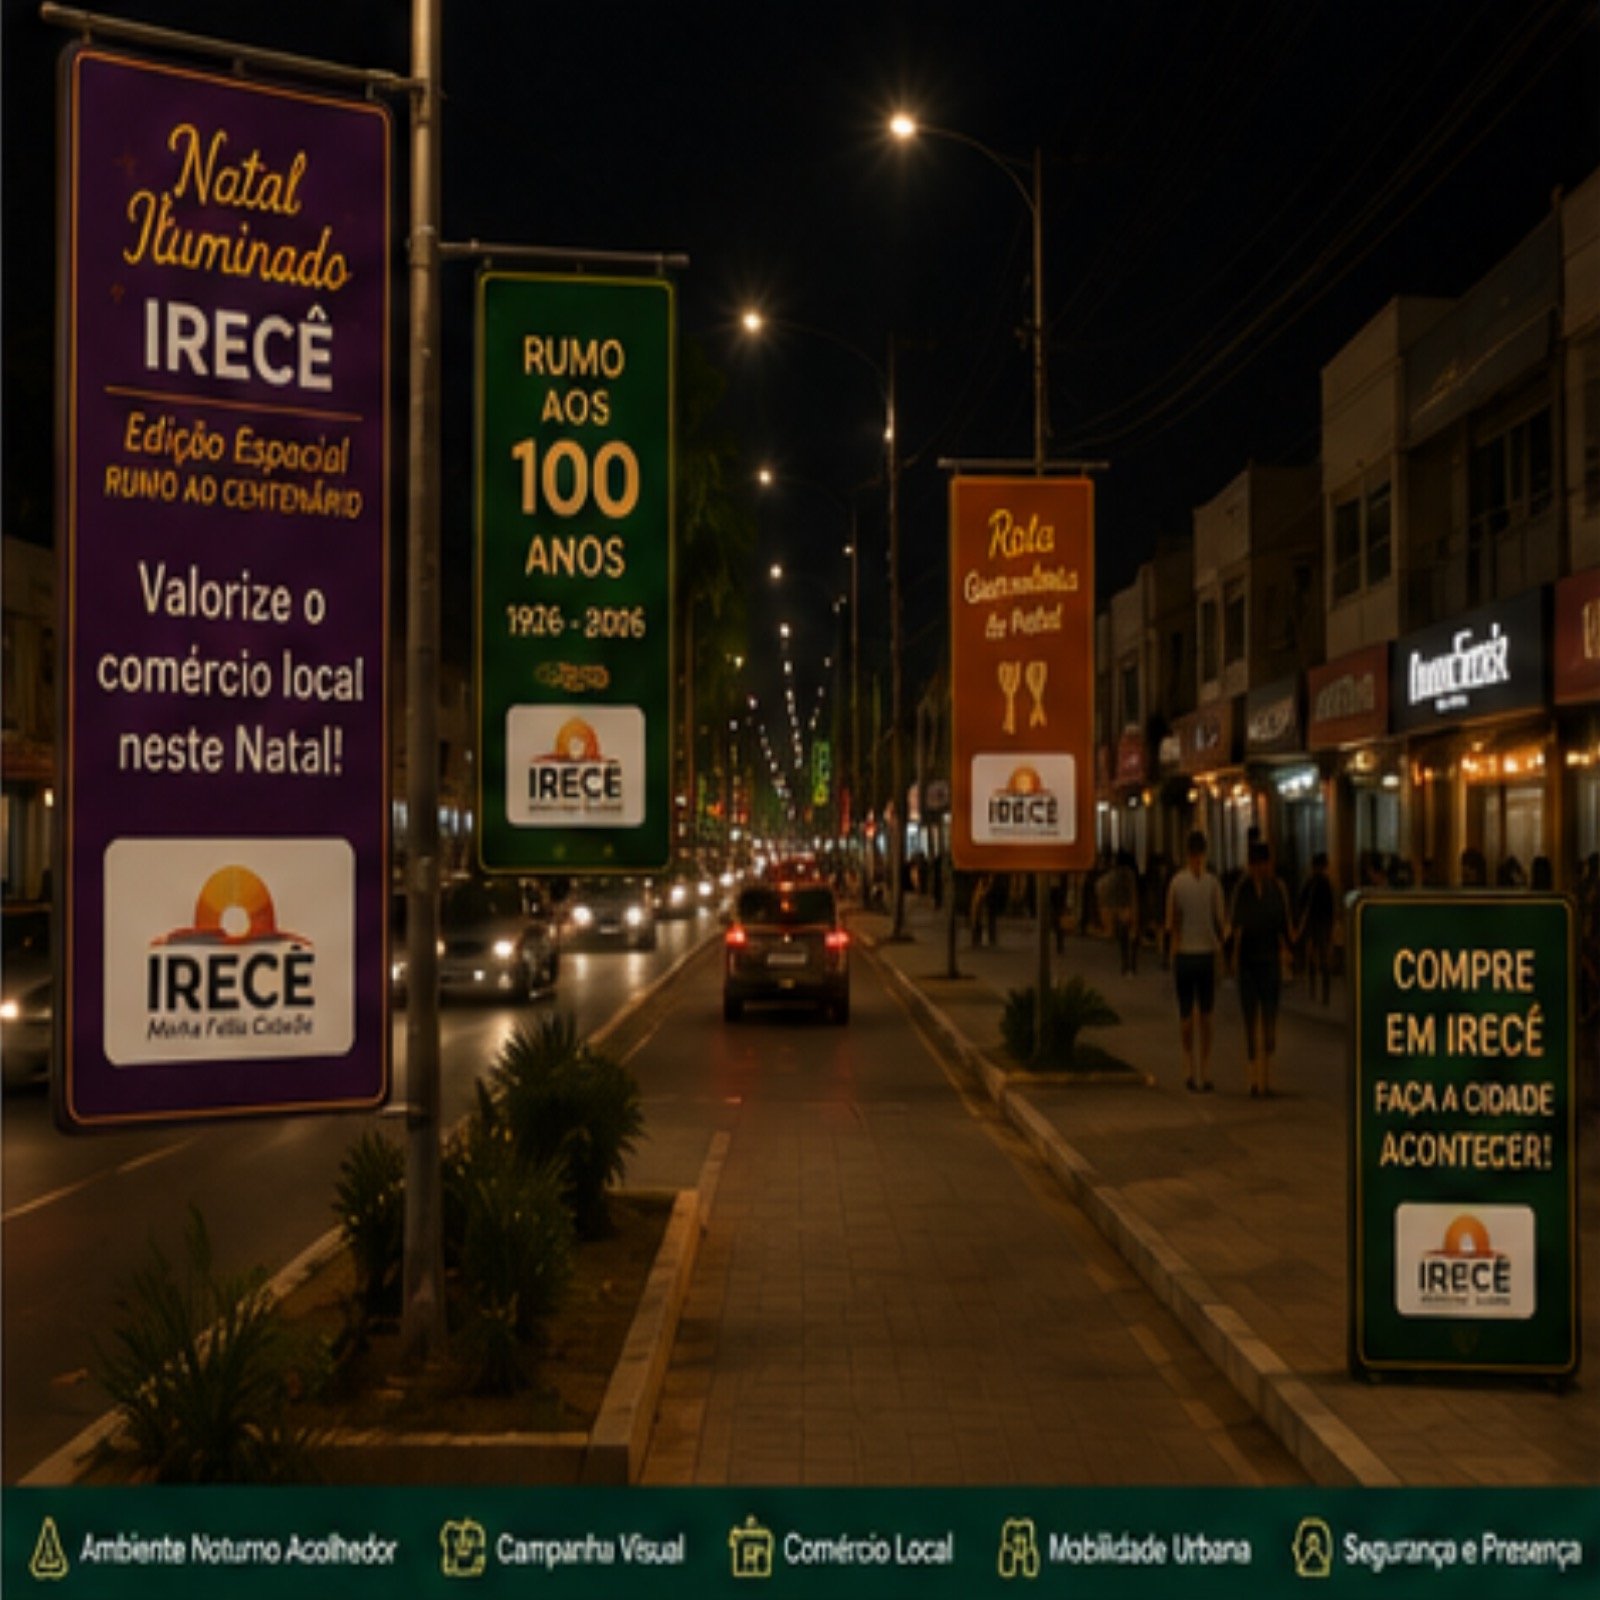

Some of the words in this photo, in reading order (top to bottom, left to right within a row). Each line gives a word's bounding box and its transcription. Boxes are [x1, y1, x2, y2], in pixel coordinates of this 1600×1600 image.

[168, 122, 307, 216] Natal
[122, 188, 352, 292] Iluminado
[143, 297, 335, 393] IRECÊ
[523, 335, 625, 380] RUMO
[541, 389, 611, 427] AOS
[124, 411, 226, 468] Edição
[510, 437, 640, 519] 100
[524, 535, 627, 580] ANOS
[138, 560, 292, 624] Valorize
[303, 588, 328, 626] o
[97, 645, 272, 699] comércio
[282, 650, 365, 703] local
[118, 728, 225, 774] neste
[235, 724, 344, 776] Natal!
[1393, 947, 1536, 993] COMPRE
[1386, 1013, 1436, 1057] EM
[1375, 1081, 1437, 1118] FAÇA
[1442, 1084, 1460, 1113] A
[1464, 1081, 1555, 1118] CIDADE
